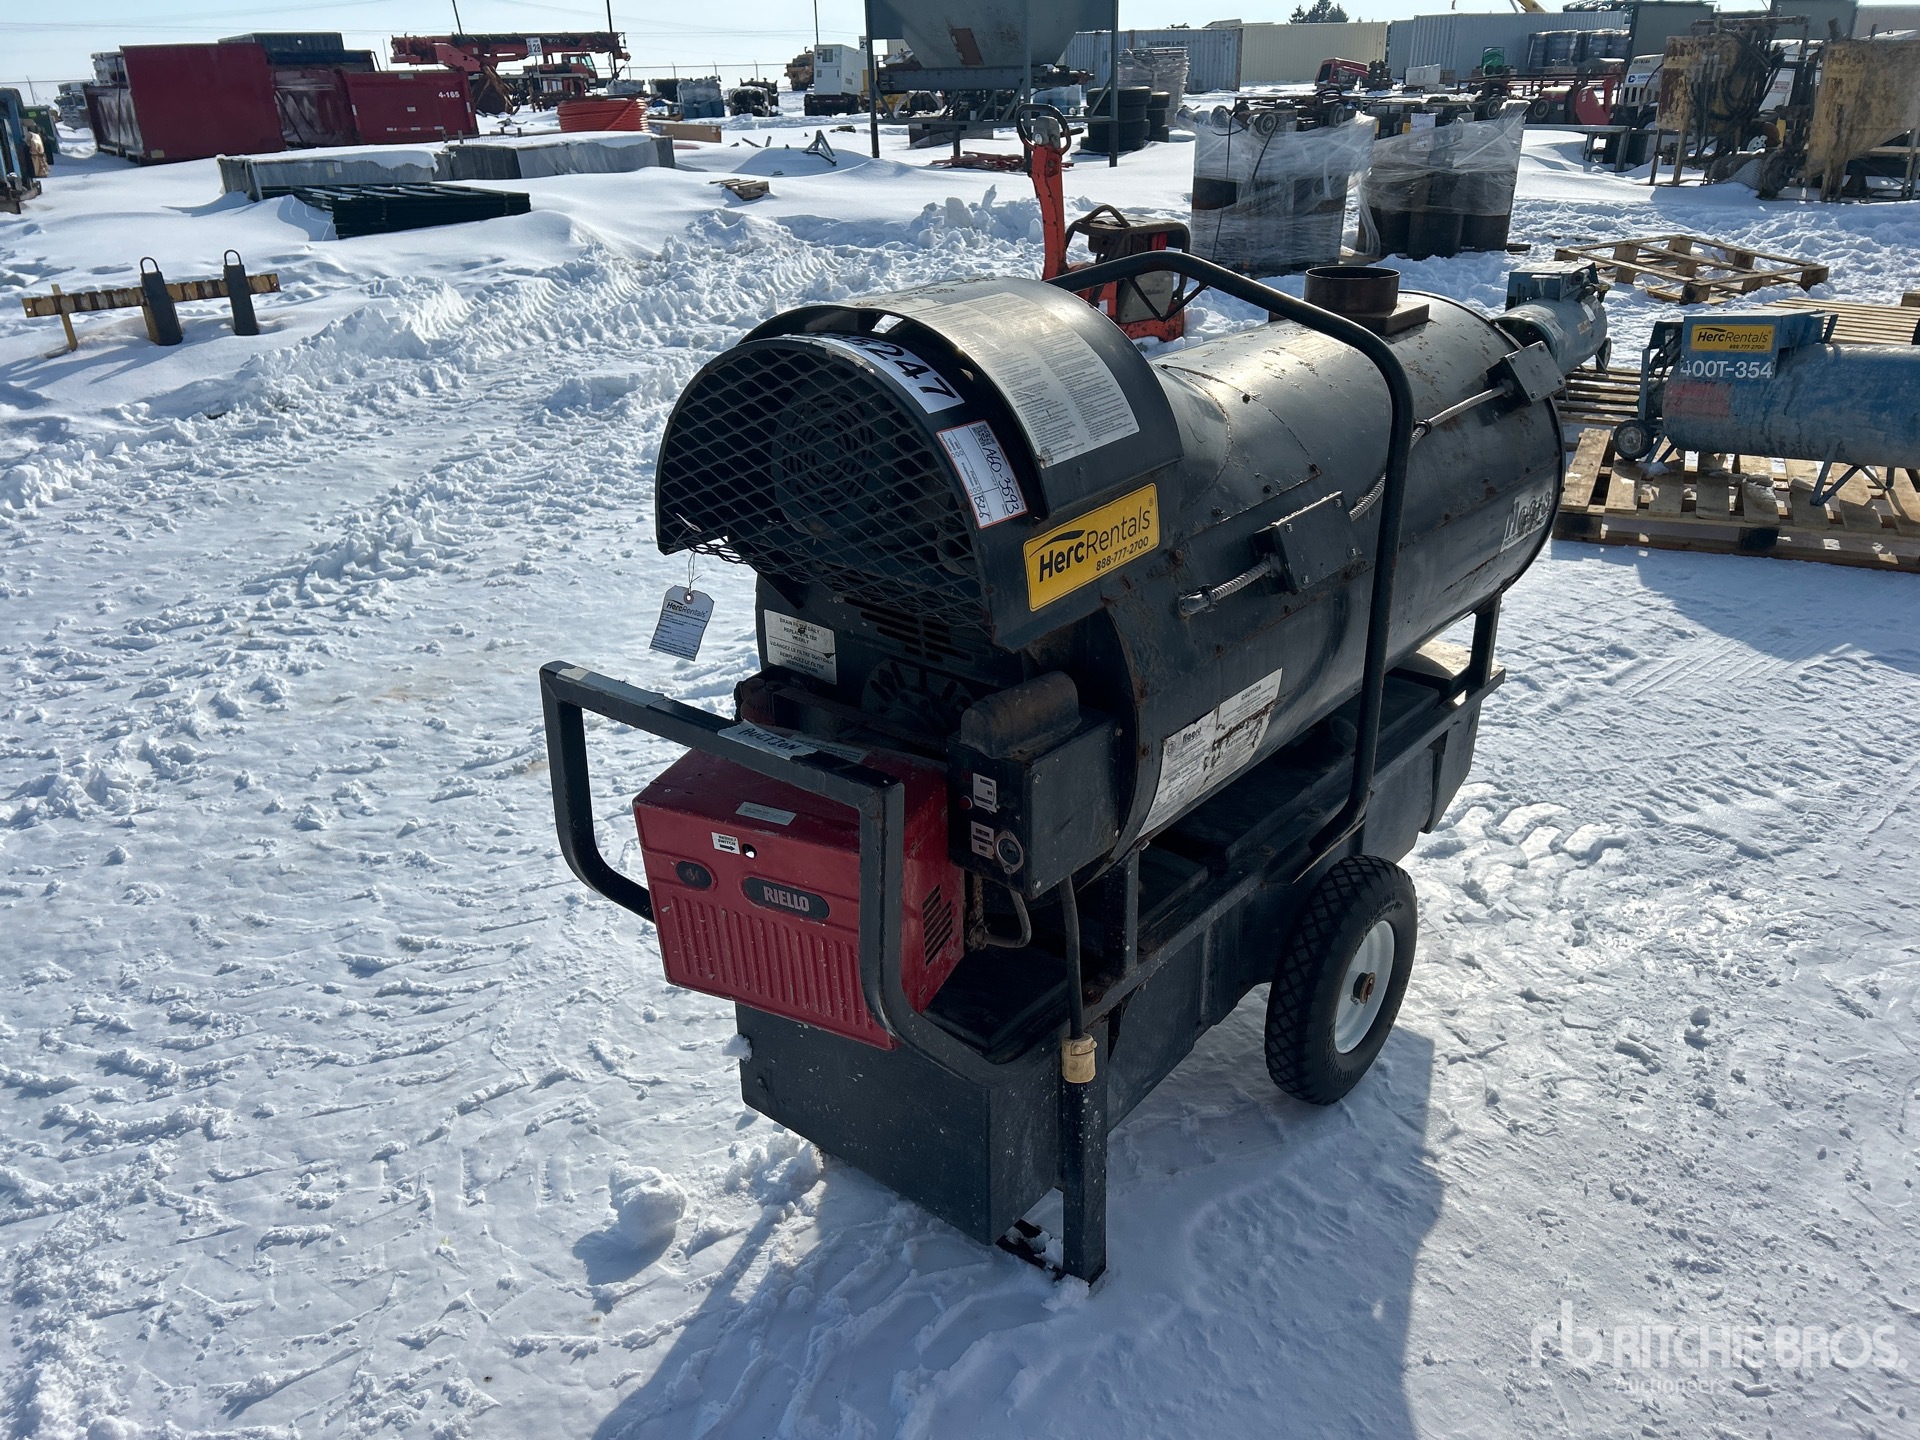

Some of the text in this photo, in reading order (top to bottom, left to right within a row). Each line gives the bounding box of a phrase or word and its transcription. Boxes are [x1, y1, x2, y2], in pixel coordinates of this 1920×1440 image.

[1697, 331, 1769, 343] HercRentals
[1680, 360, 1773, 379] 400T-354
[1039, 506, 1151, 583] HercRentals
[1096, 536, 1149, 571] 888-777-2700
[1241, 683, 1262, 701] CAUTION
[738, 728, 802, 751] AUCTION
[763, 885, 810, 912] RIELLO
